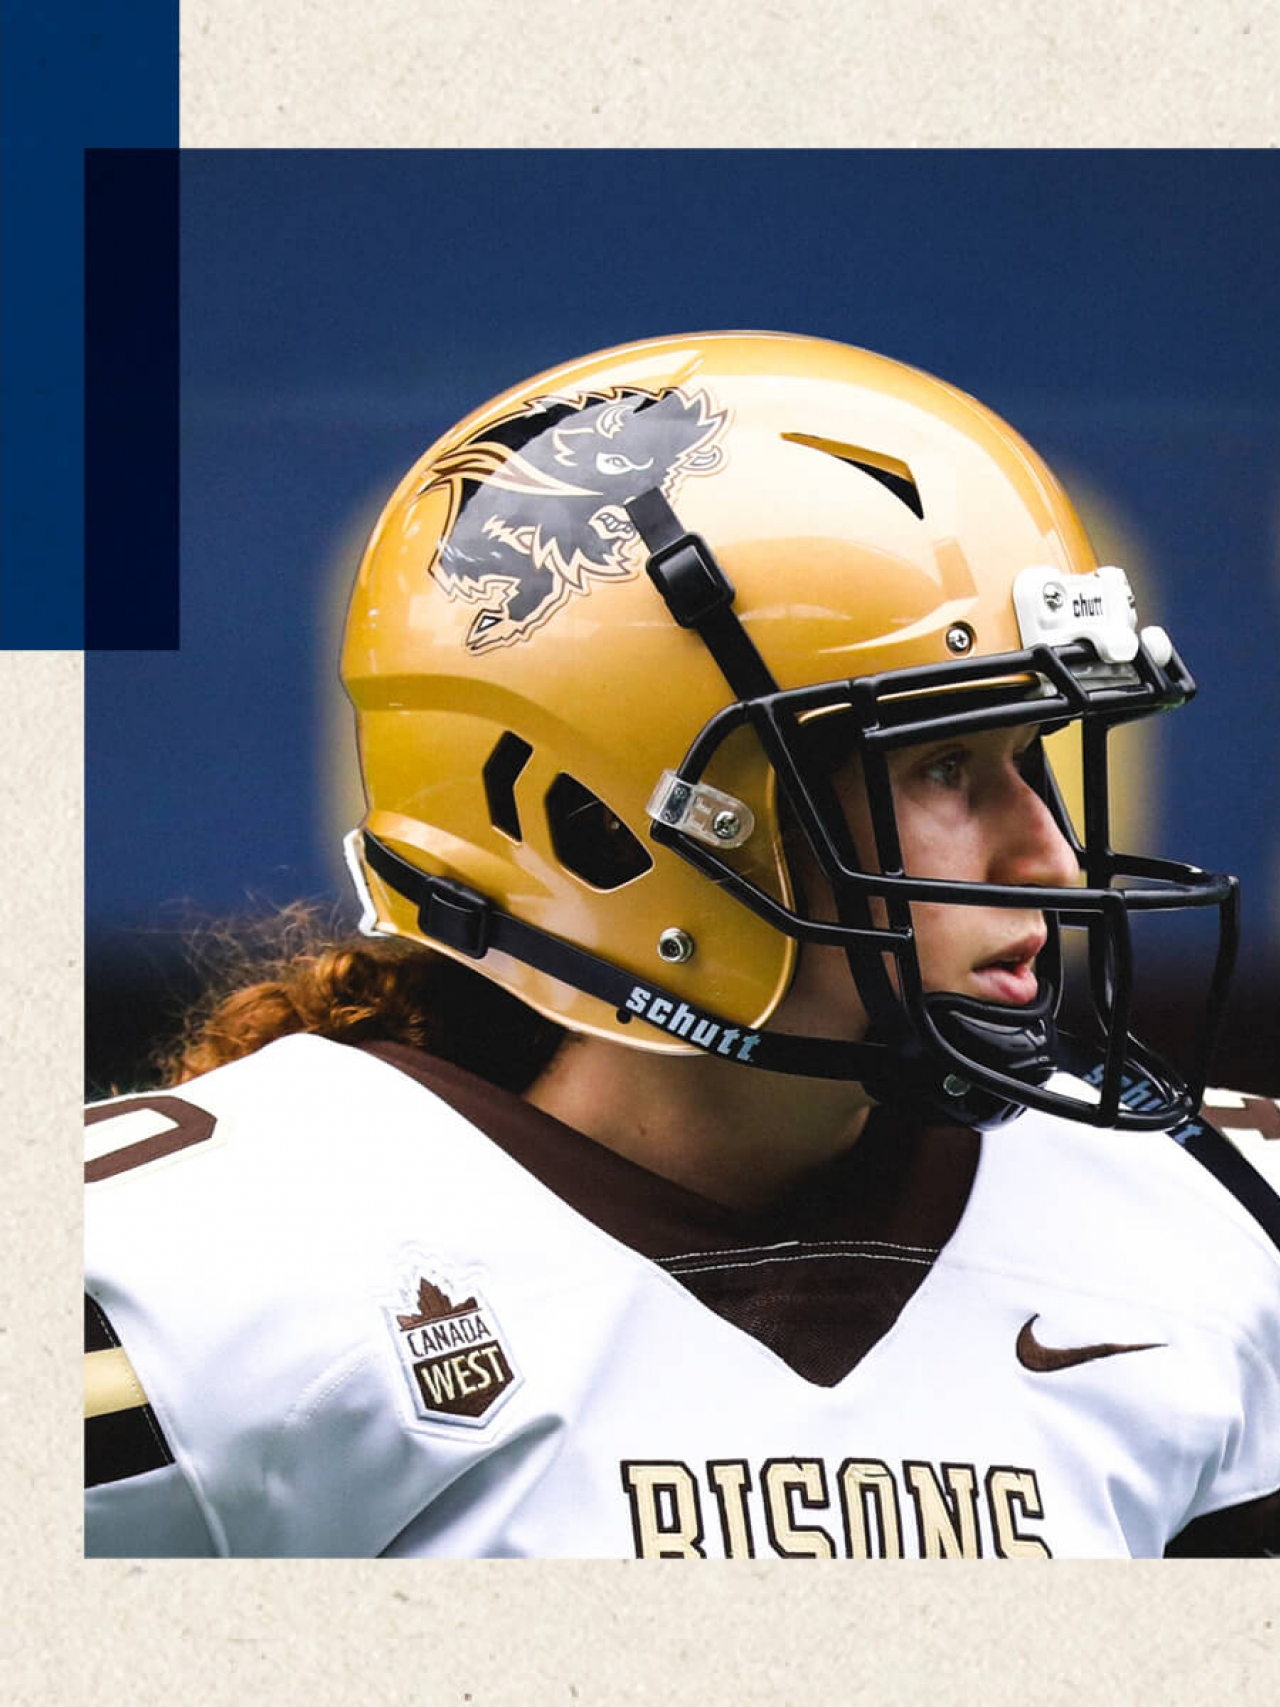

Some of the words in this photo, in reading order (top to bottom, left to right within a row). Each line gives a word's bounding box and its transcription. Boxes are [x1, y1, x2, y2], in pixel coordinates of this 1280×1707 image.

[625, 986, 761, 1062] schutt
[407, 1314, 492, 1358] CANADA
[421, 1345, 505, 1405] WEST
[621, 1456, 1053, 1559] BISONS
